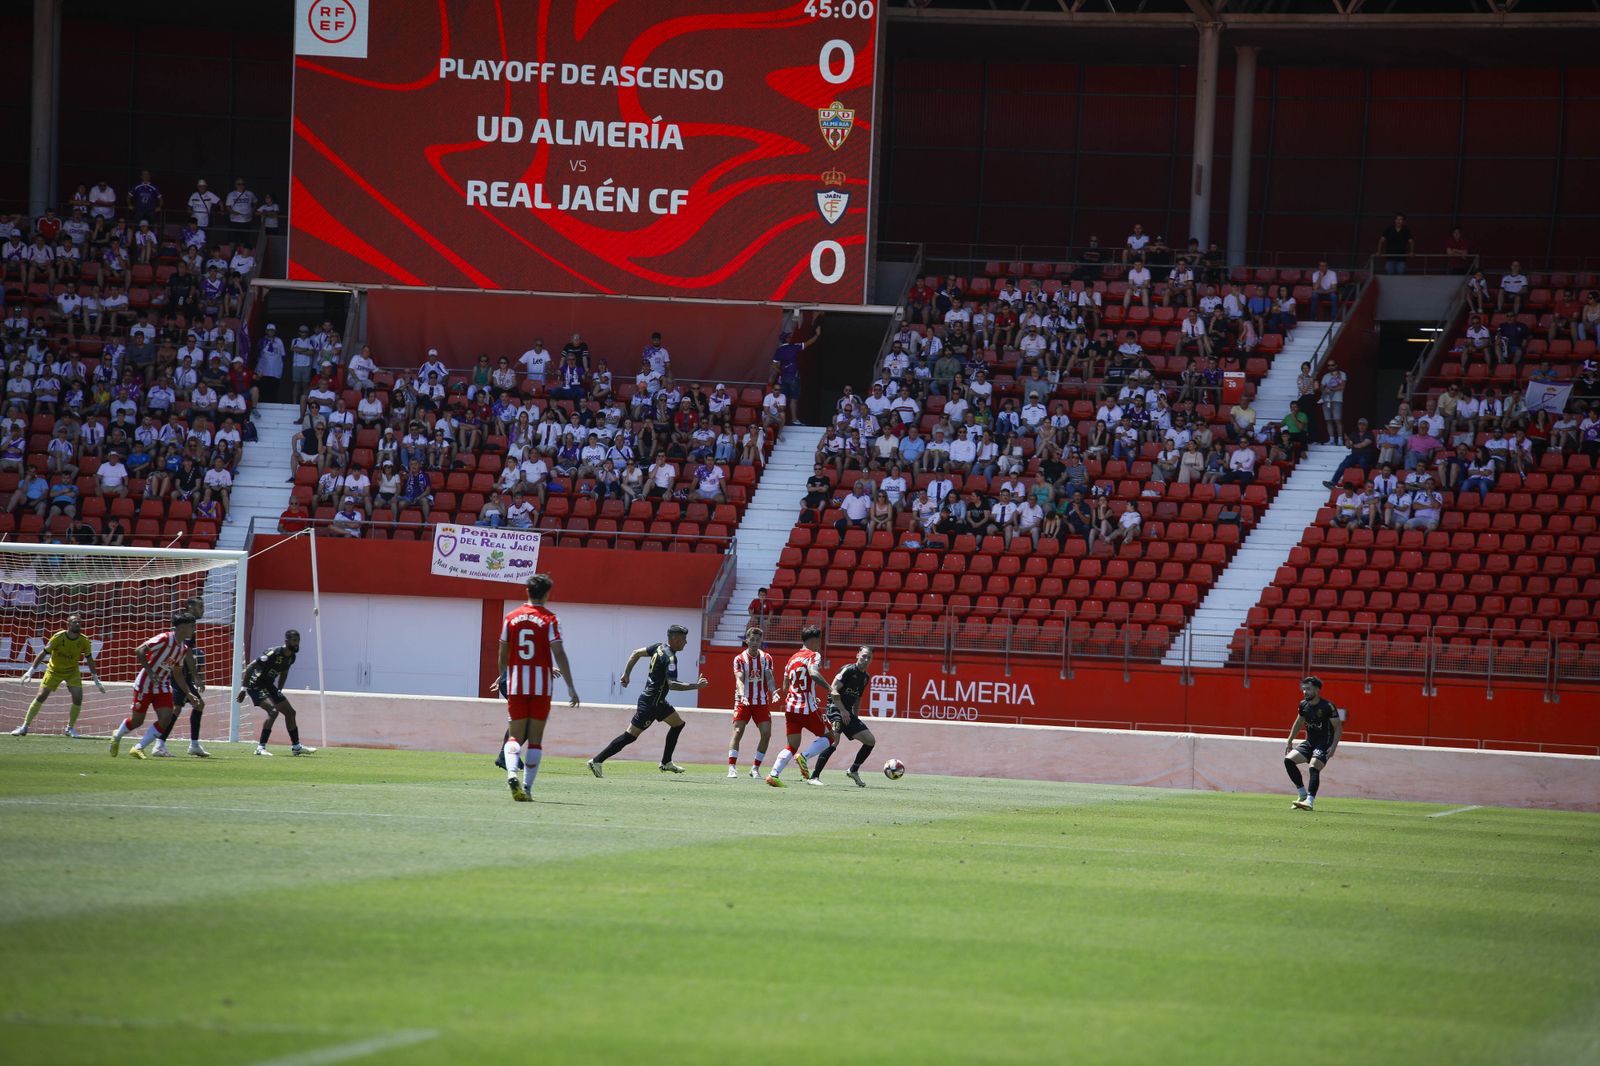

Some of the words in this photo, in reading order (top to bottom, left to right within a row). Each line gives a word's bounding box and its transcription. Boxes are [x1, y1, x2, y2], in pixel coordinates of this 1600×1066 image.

[803, 0, 874, 19] 45:00
[439, 57, 556, 83] PLAYOFF
[561, 63, 596, 85] DE
[600, 65, 724, 91] ASCENSO
[819, 39, 855, 84] 0
[477, 115, 524, 143] UD
[529, 114, 684, 151] ALMERÍA
[569, 159, 587, 172] VS
[466, 180, 552, 209] REAL
[557, 177, 640, 213] JAÉN
[648, 188, 689, 215] CF
[810, 239, 846, 285] 0
[460, 537, 477, 546] DEL
[461, 526, 498, 538] Peña
[500, 532, 539, 542] AMIGOS
[518, 628, 535, 660] 5
[788, 666, 807, 693] 23
[921, 679, 1035, 706] ALMERIA
[919, 704, 978, 721] CIUDAD
